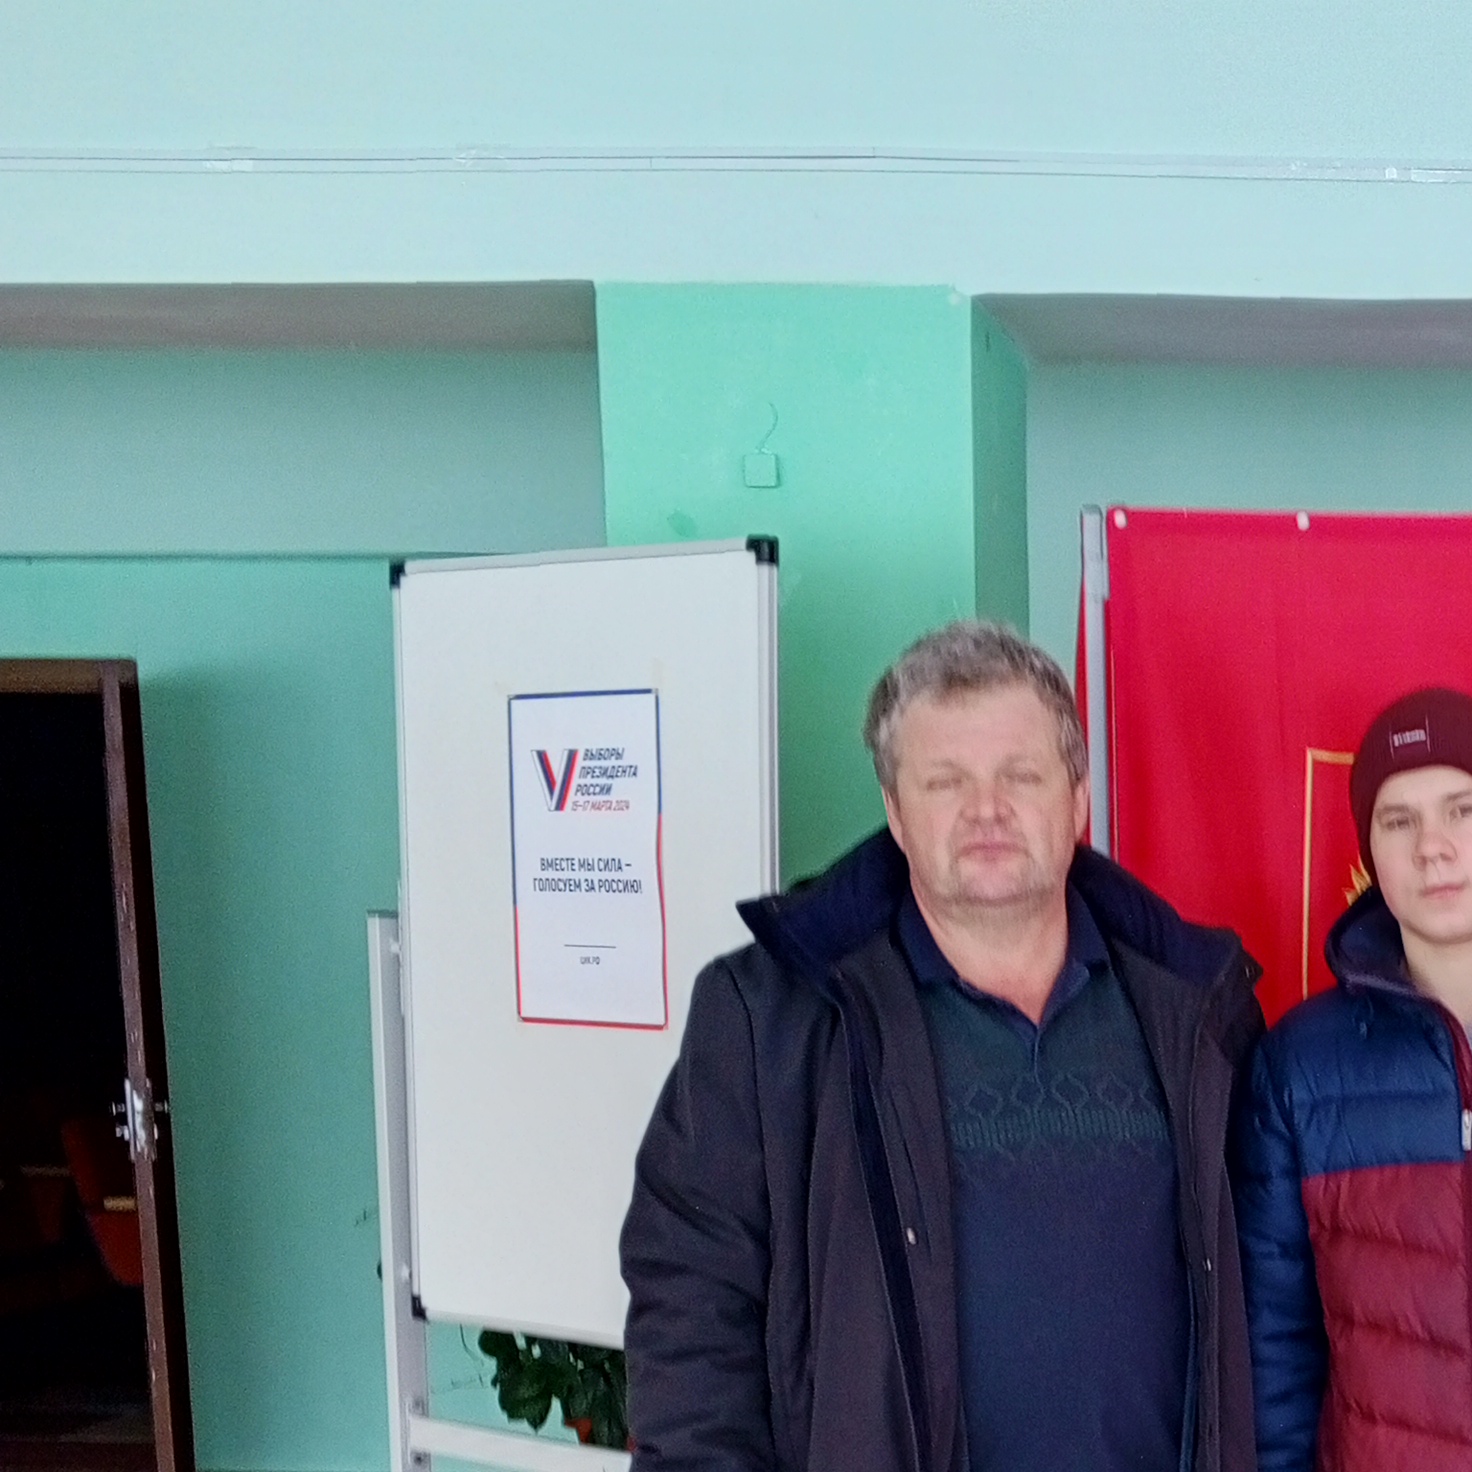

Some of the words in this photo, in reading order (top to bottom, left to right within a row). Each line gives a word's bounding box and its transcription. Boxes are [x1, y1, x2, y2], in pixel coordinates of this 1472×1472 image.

[583, 748, 625, 761] ВЫБОРЫ
[579, 765, 638, 779] ПРЕЗИДЕНТА
[574, 783, 613, 796] РОССИИ
[590, 800, 613, 811] МАРТА
[613, 800, 630, 811] 2024
[540, 857, 576, 872] ВМЕСТЕ
[578, 858, 595, 872] МЫ
[597, 858, 623, 872] СИЛА
[533, 878, 582, 893] ГОЛОСУЕМ
[584, 878, 597, 893] ЗА
[598, 879, 643, 894] РОССИЮ!
